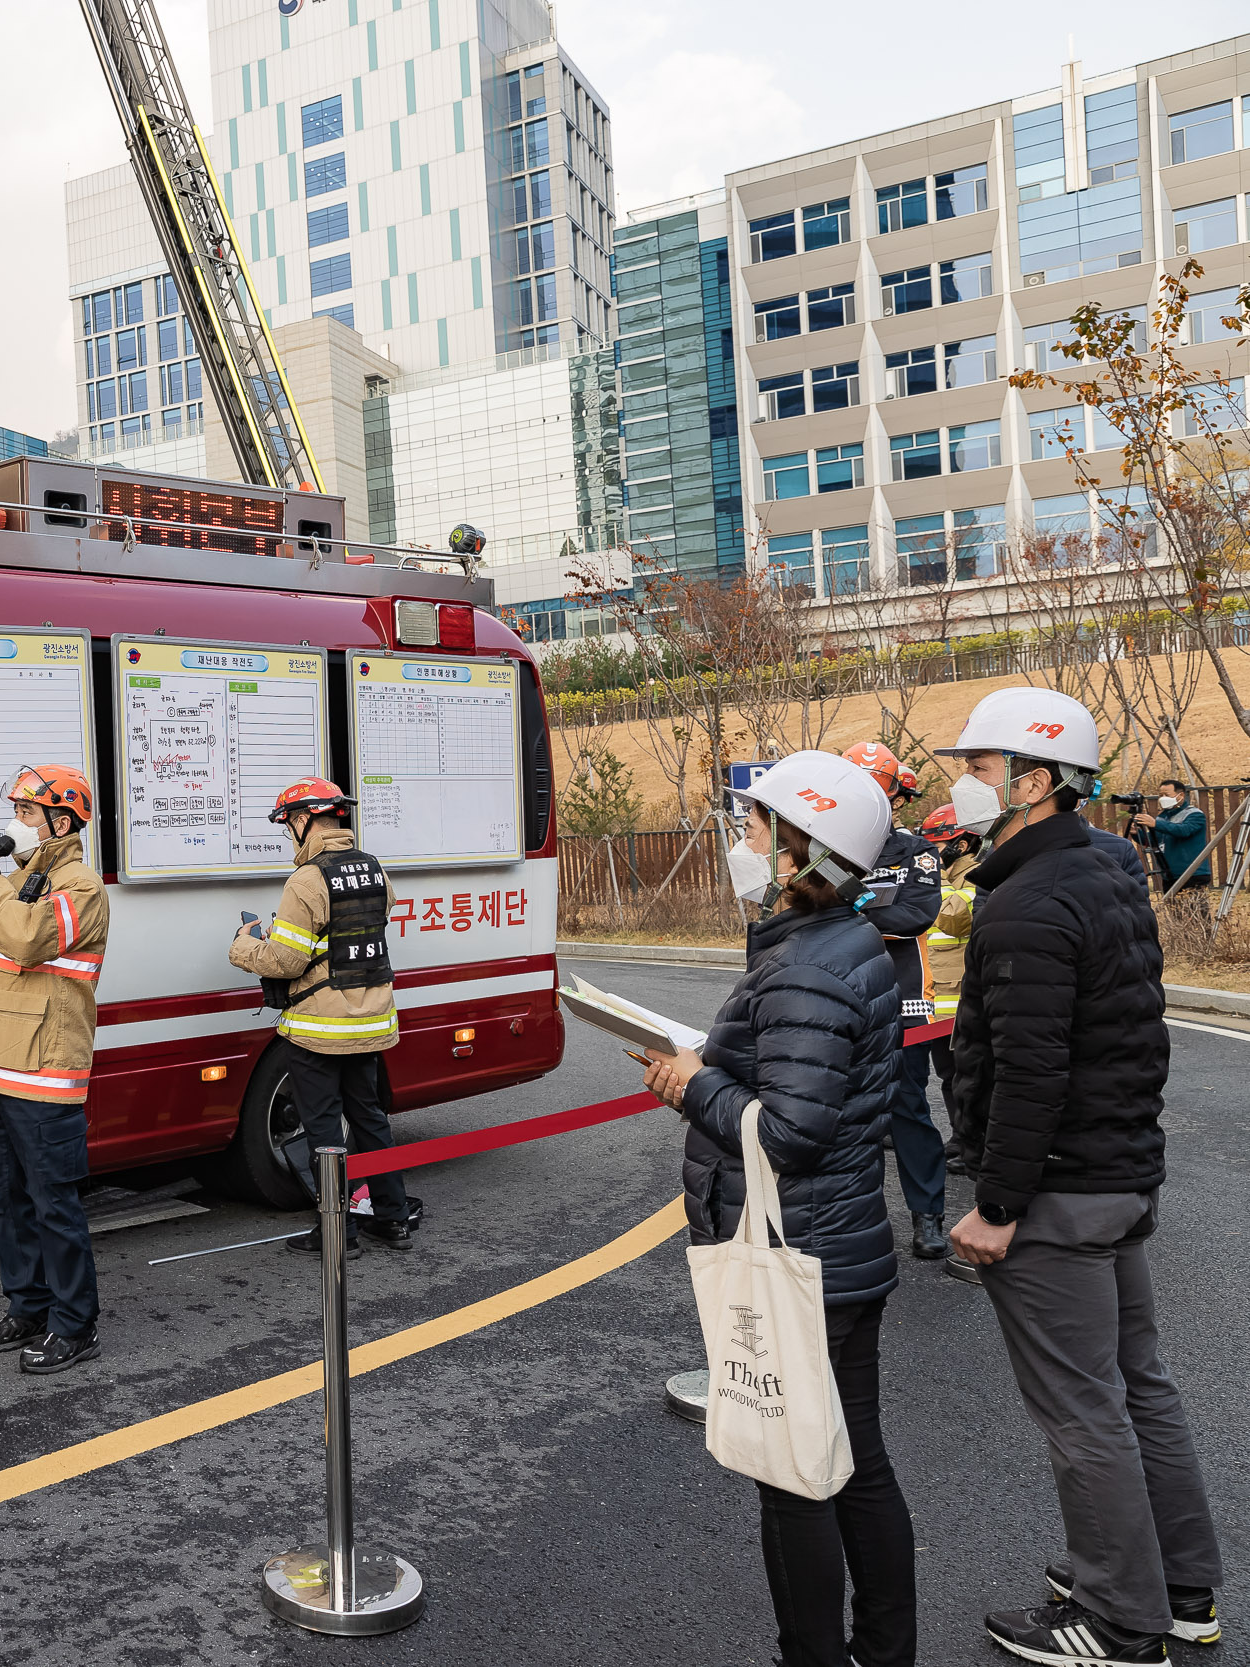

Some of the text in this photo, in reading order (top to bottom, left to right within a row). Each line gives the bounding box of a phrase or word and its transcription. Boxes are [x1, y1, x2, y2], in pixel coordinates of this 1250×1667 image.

[42, 642, 79, 655] 광진소방서
[197, 654, 254, 667] 재난대응 작전도
[288, 658, 318, 669] 광진소방서
[416, 667, 458, 679] 인명피해상황
[488, 670, 511, 680] 광진소방서
[1025, 721, 1065, 740] 119
[796, 787, 838, 813] 119
[340, 862, 370, 873] 서울소방
[330, 873, 384, 891] 화재조사
